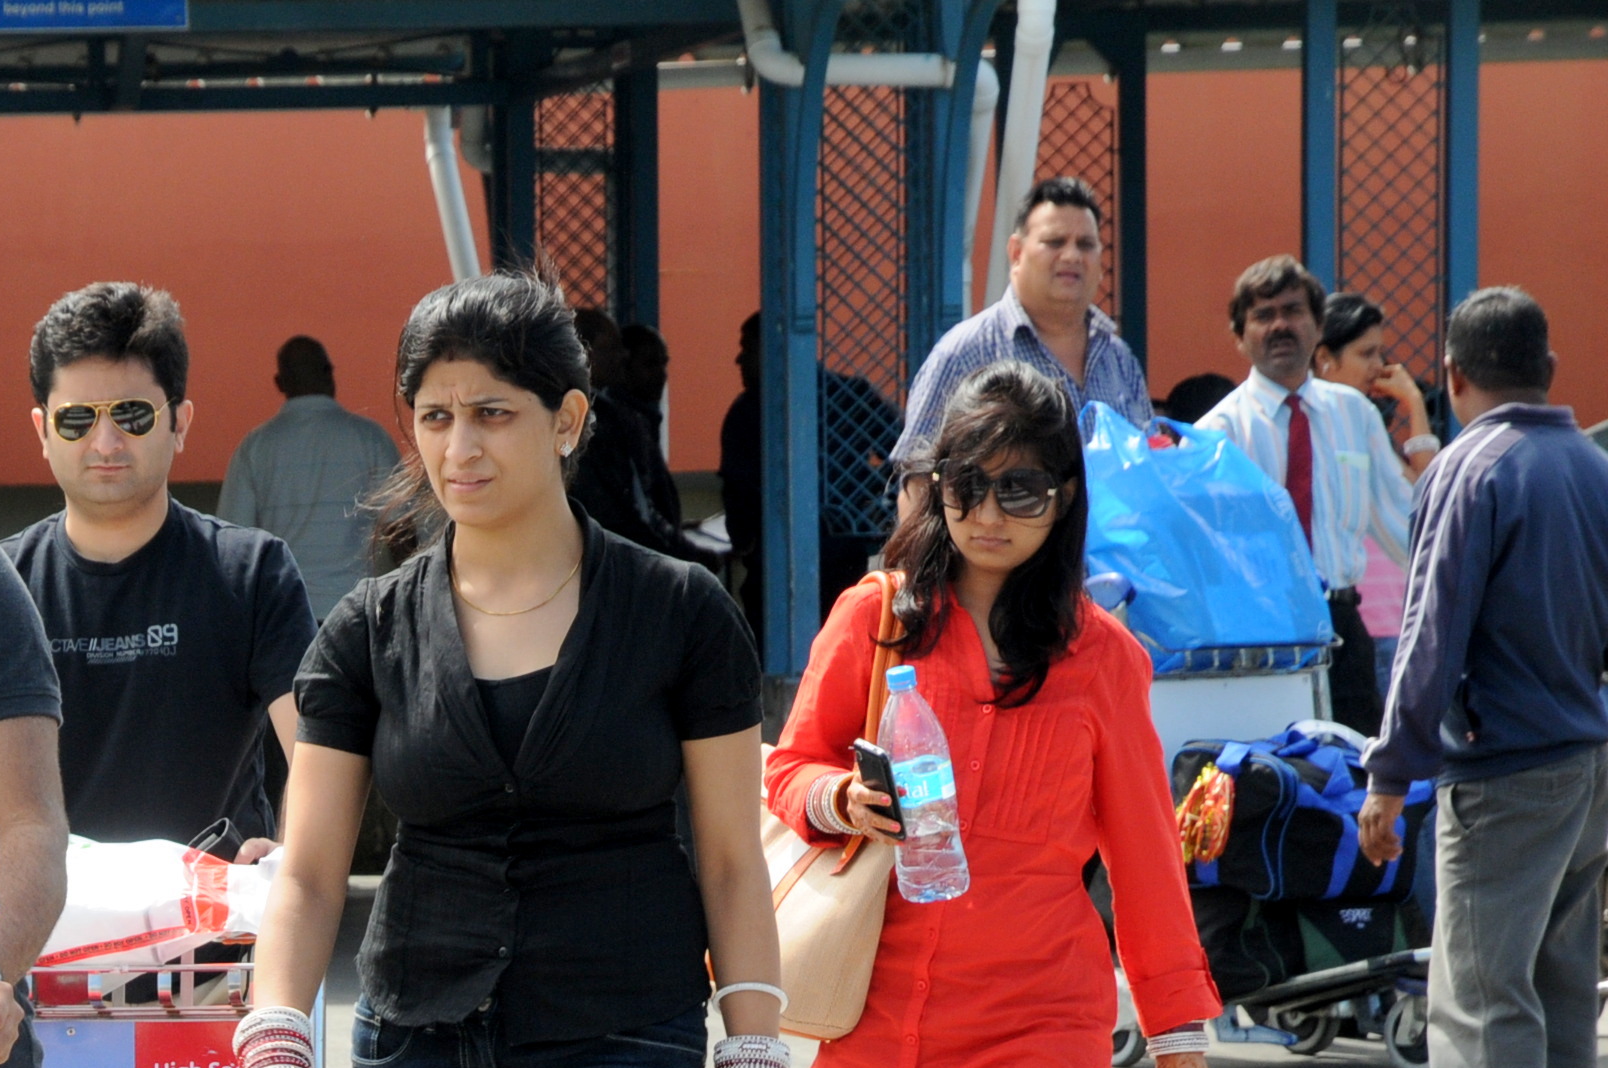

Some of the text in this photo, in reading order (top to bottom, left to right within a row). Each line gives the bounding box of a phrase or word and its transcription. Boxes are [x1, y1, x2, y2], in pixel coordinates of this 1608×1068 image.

[3, 0, 124, 16] beyond this point
[147, 624, 178, 647] 09
[905, 780, 929, 798] tal
